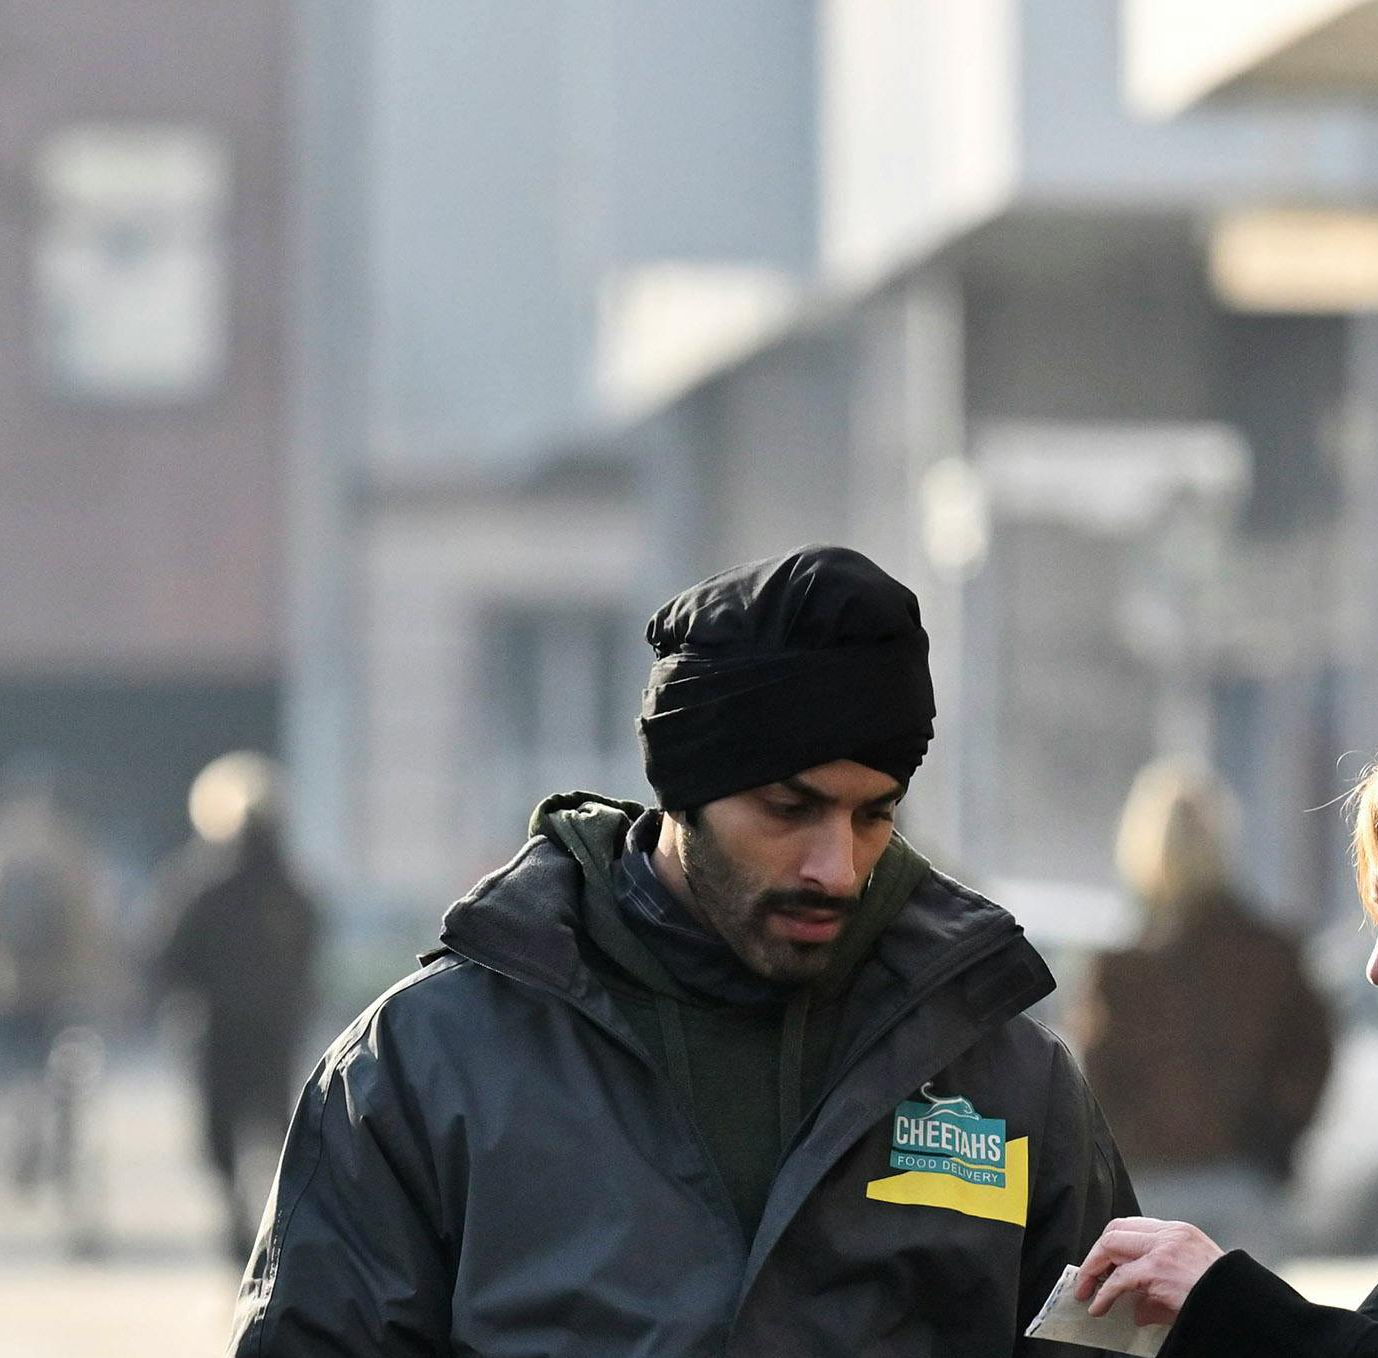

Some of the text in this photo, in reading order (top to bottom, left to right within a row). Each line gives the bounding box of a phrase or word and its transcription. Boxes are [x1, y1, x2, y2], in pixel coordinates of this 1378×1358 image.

[895, 1115, 1001, 1162] CHEETAHS
[896, 1155, 999, 1183] FOOD DELIVERY
